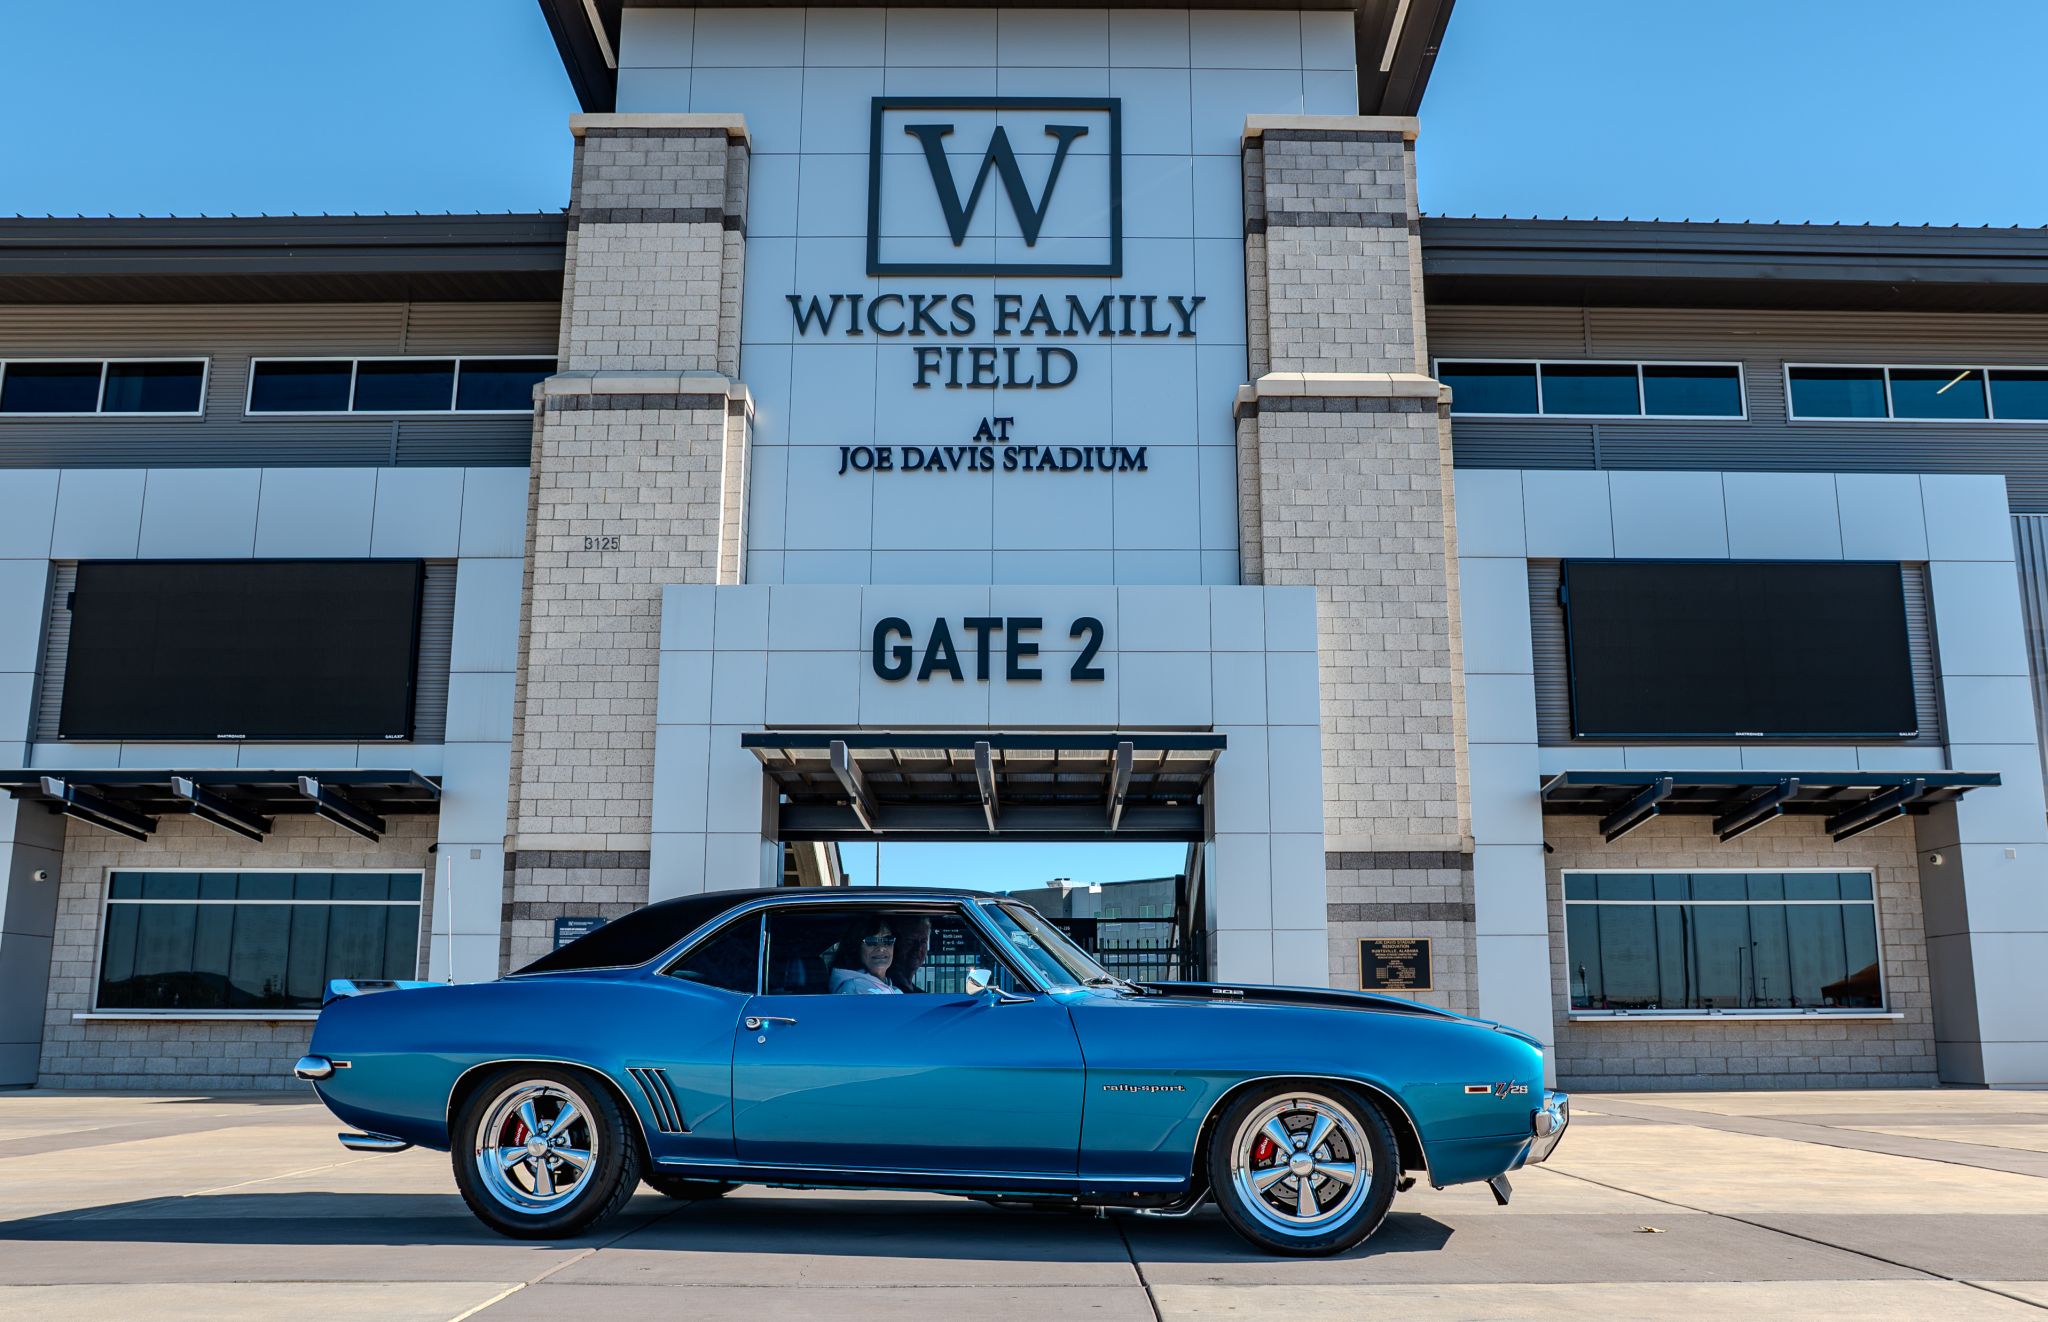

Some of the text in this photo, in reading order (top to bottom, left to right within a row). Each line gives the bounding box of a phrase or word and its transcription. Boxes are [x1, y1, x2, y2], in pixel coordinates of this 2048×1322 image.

[904, 124, 1089, 247] W
[786, 293, 1206, 338] WICKS FAMILY
[913, 346, 1078, 389] FIELD
[973, 416, 1014, 442] AT
[838, 446, 1148, 475] JOE DAVIS STADIUM
[585, 537, 619, 551] 3125
[873, 616, 1104, 681] GATE 2
[1494, 1079, 1529, 1100] Z/28
